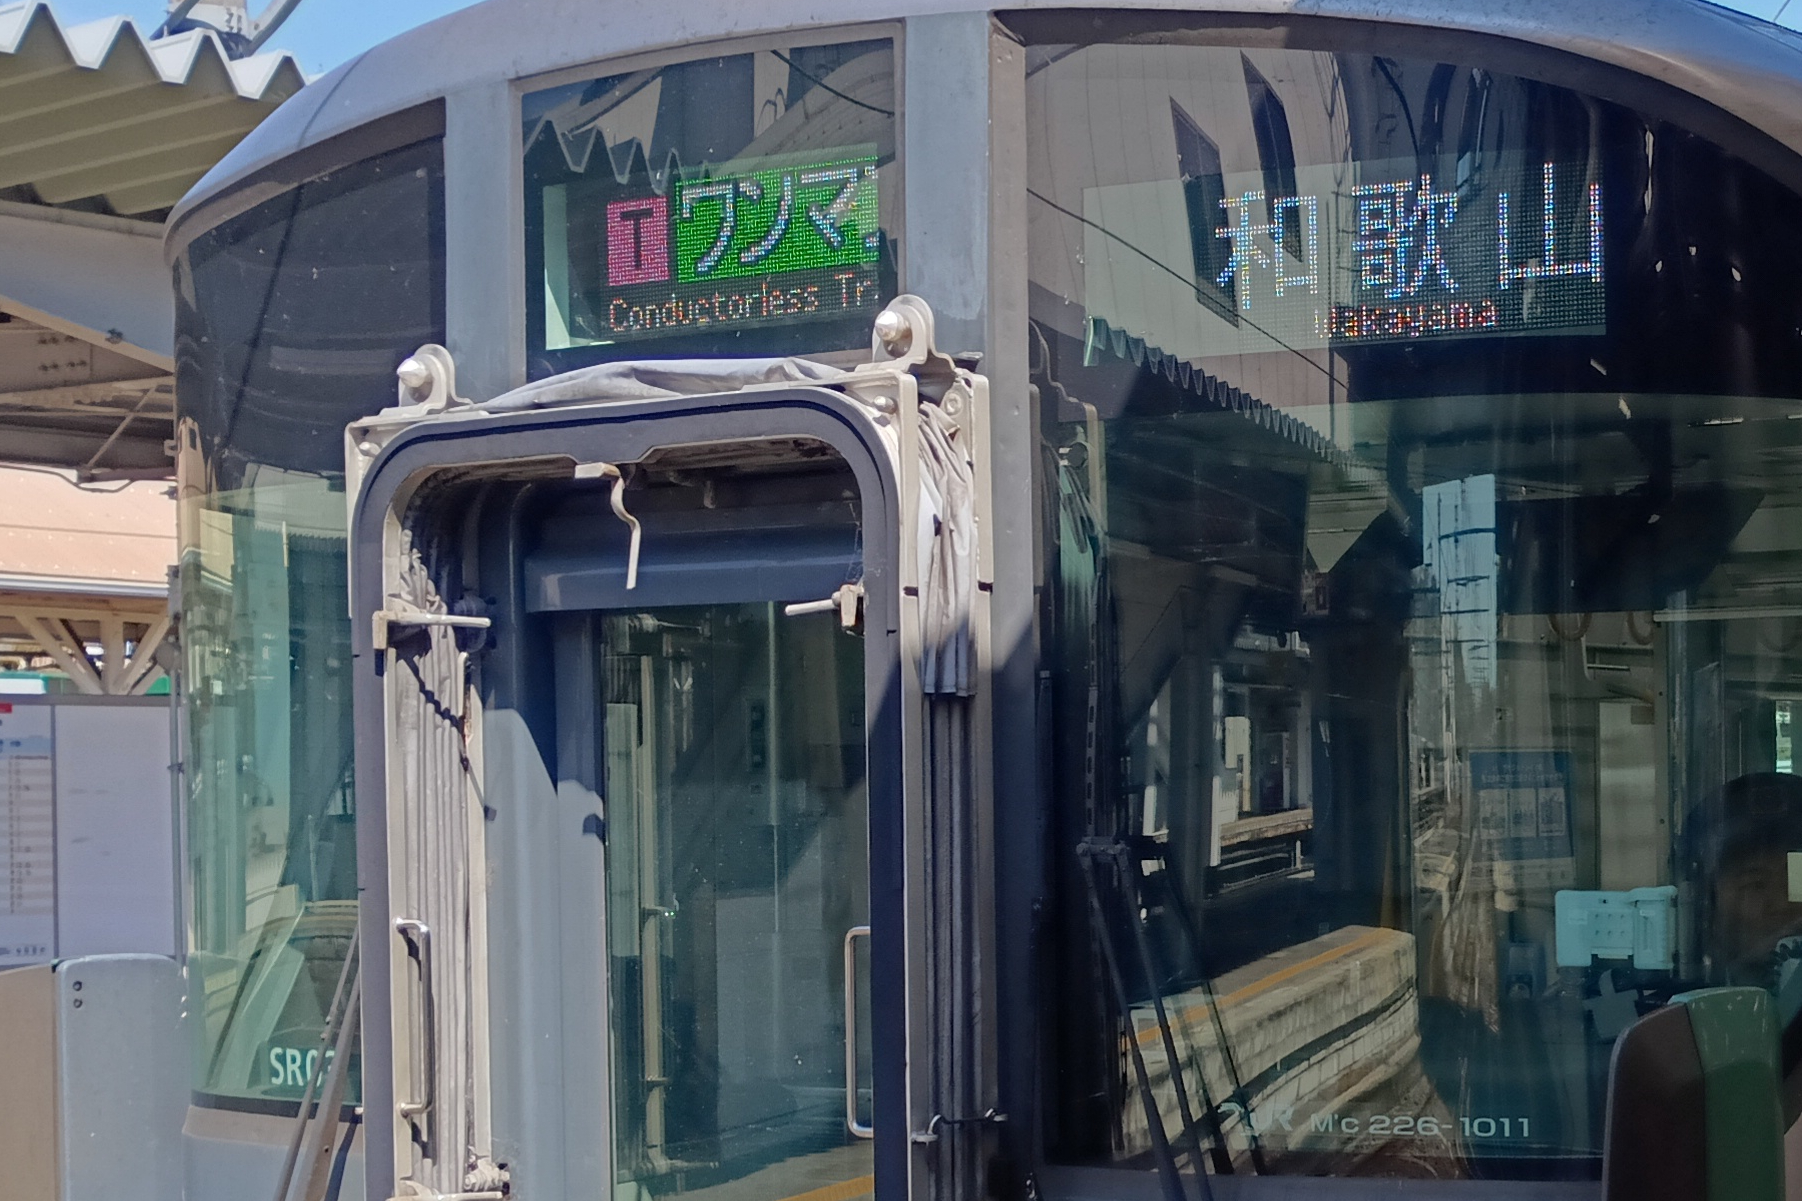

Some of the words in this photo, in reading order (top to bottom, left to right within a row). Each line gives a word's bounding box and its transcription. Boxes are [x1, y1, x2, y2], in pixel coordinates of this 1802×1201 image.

[619, 206, 653, 269] T
[682, 165, 878, 273] ワンマ
[1214, 160, 1604, 310] 和歌山
[608, 281, 819, 332] Conductorless
[834, 273, 879, 308] Tr
[1368, 1113, 1531, 1138] 226-1011
